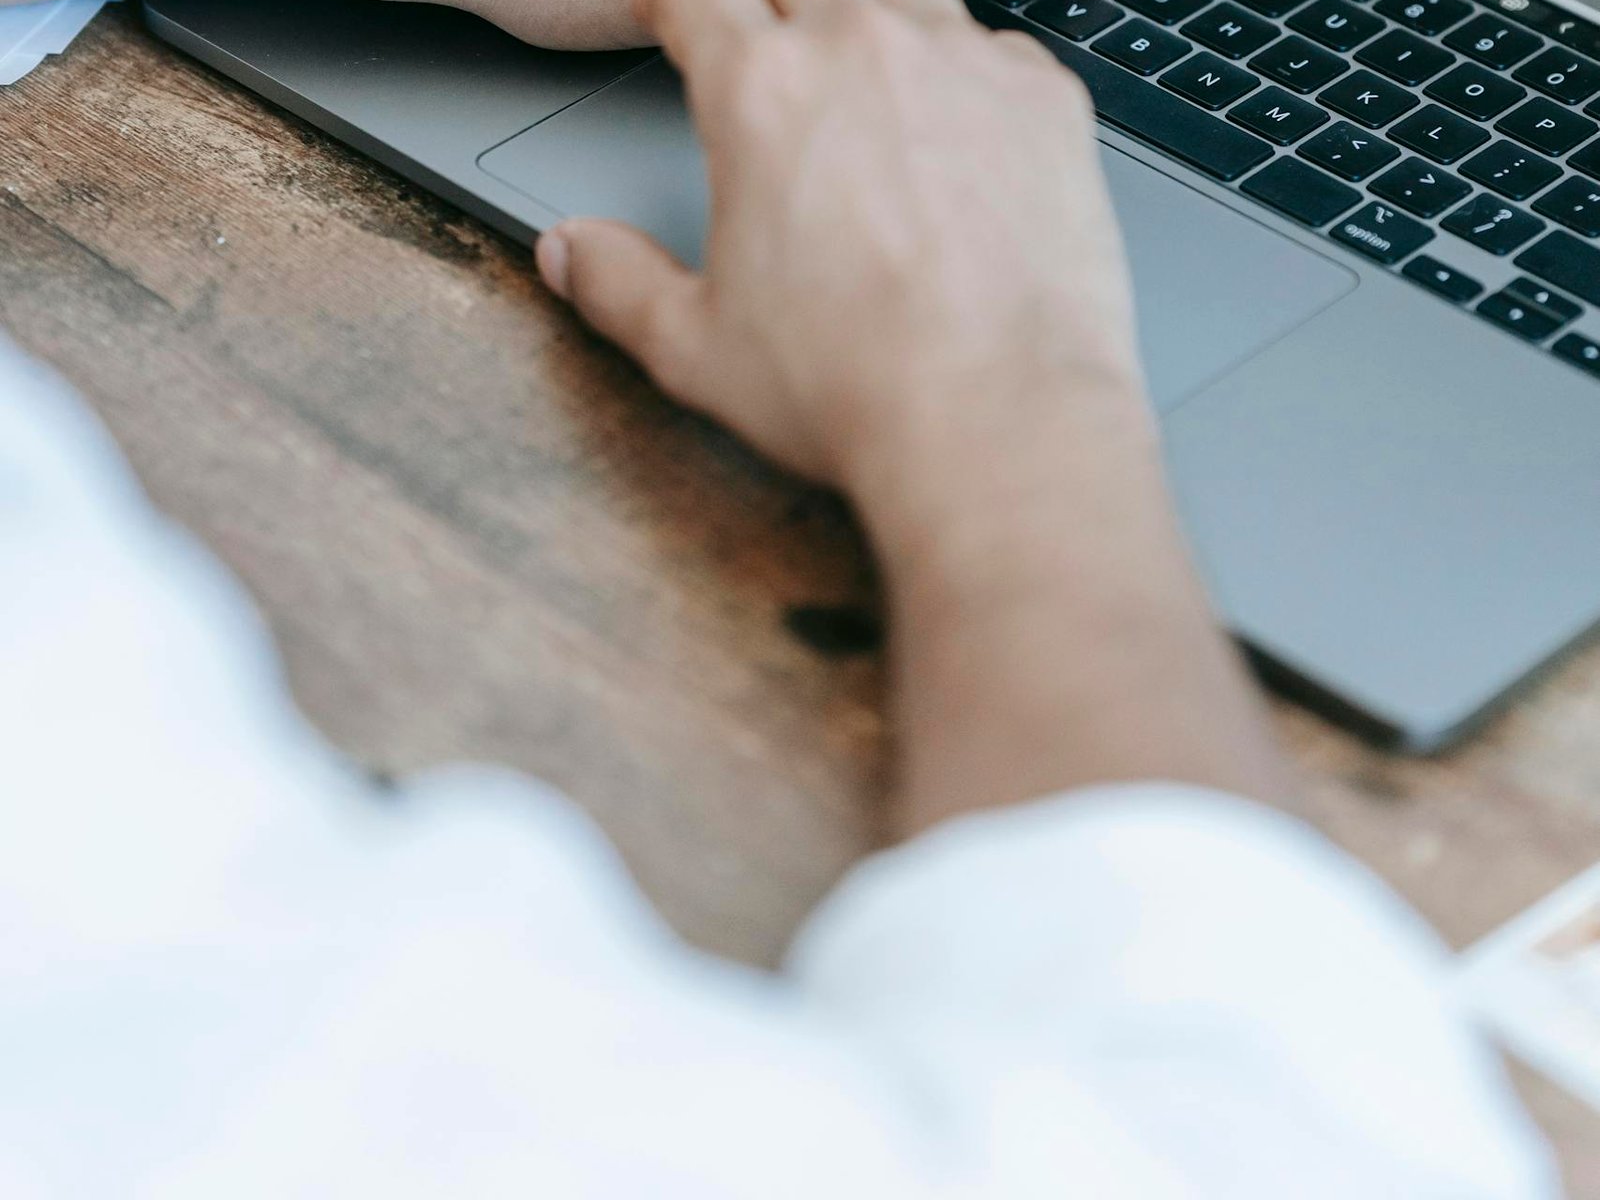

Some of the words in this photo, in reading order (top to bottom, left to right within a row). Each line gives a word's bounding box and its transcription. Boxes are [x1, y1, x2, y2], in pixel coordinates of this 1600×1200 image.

[1066, 3, 1087, 17] V
[1404, 4, 1425, 18] 8
[1325, 14, 1348, 29] U
[1219, 21, 1242, 37] H
[1130, 38, 1151, 52] B
[1475, 38, 1495, 51] 9
[1289, 59, 1309, 69] J
[1197, 72, 1221, 87] N
[1465, 84, 1485, 96] O
[1356, 91, 1379, 105] K
[1265, 106, 1291, 122] M
[1535, 118, 1556, 129] P
[1428, 126, 1443, 140] L
[1344, 224, 1391, 251] option
